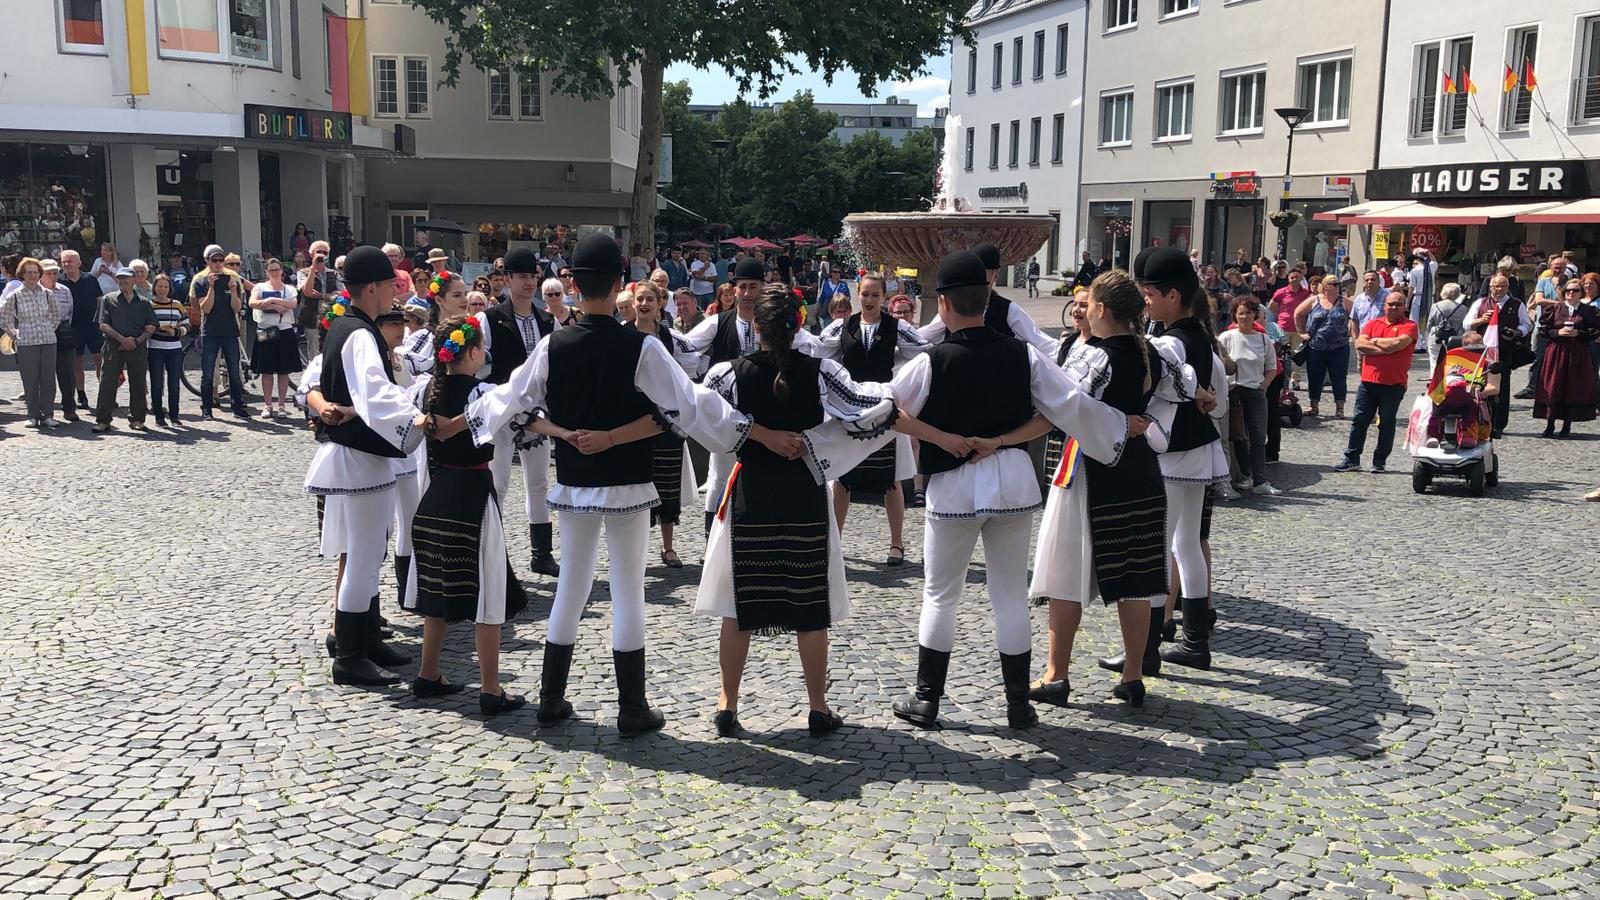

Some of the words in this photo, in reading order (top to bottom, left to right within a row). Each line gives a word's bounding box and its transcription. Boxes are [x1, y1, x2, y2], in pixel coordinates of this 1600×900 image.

[259, 113, 346, 140] BUTLERS
[1411, 167, 1564, 193] KLAUSER
[1411, 233, 1441, 247] 50%
